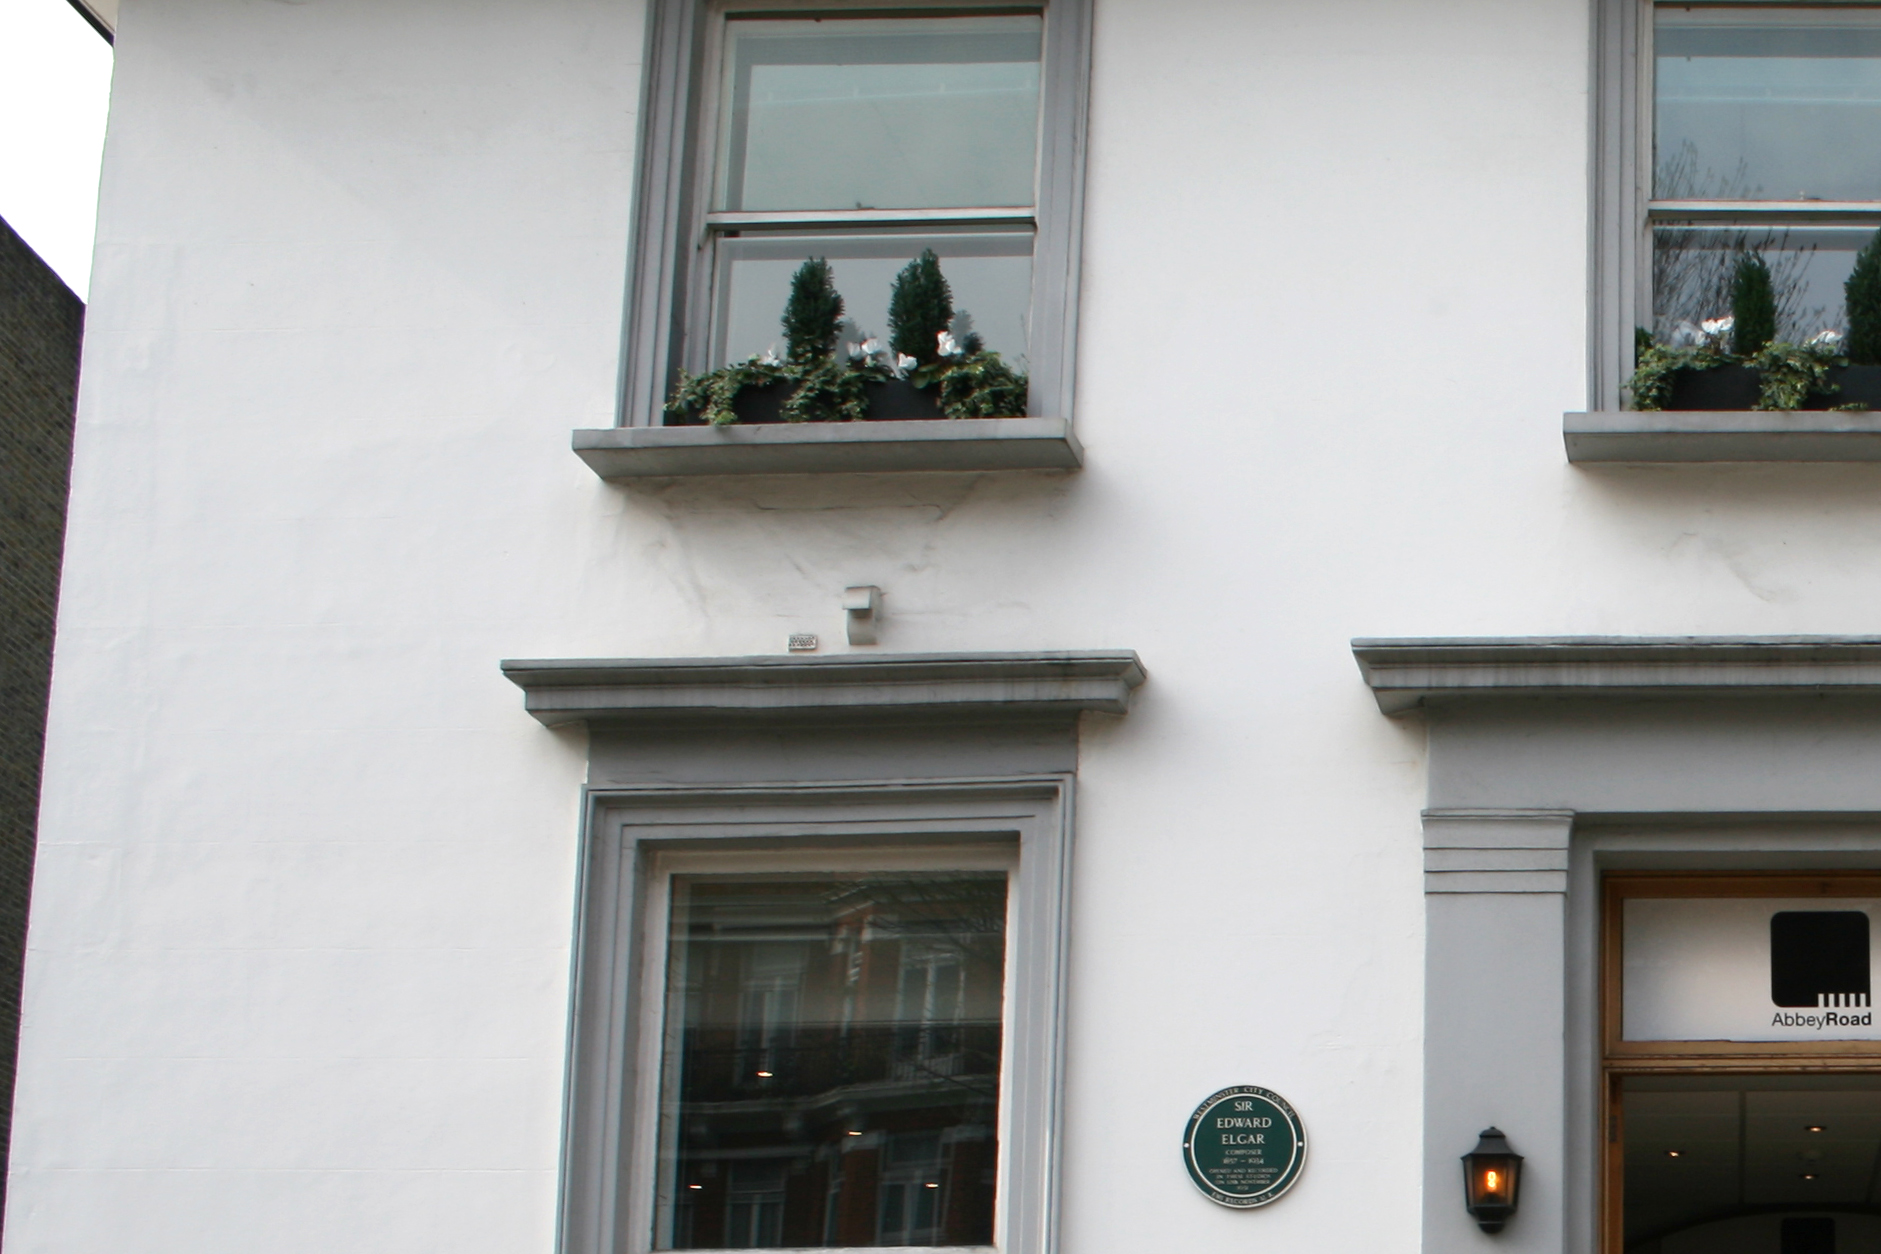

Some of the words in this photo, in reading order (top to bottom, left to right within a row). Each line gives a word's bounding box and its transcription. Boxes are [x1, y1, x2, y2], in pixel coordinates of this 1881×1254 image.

[1771, 1012, 1872, 1030] AbbeyRoad
[1193, 1087, 1239, 1120] WESTMINSTER
[1243, 1086, 1264, 1095] CITY
[1266, 1091, 1295, 1118] COUNCIL
[1234, 1101, 1253, 1111] SIR
[1216, 1117, 1272, 1128] EDWARD
[1222, 1134, 1265, 1145] ELGAR
